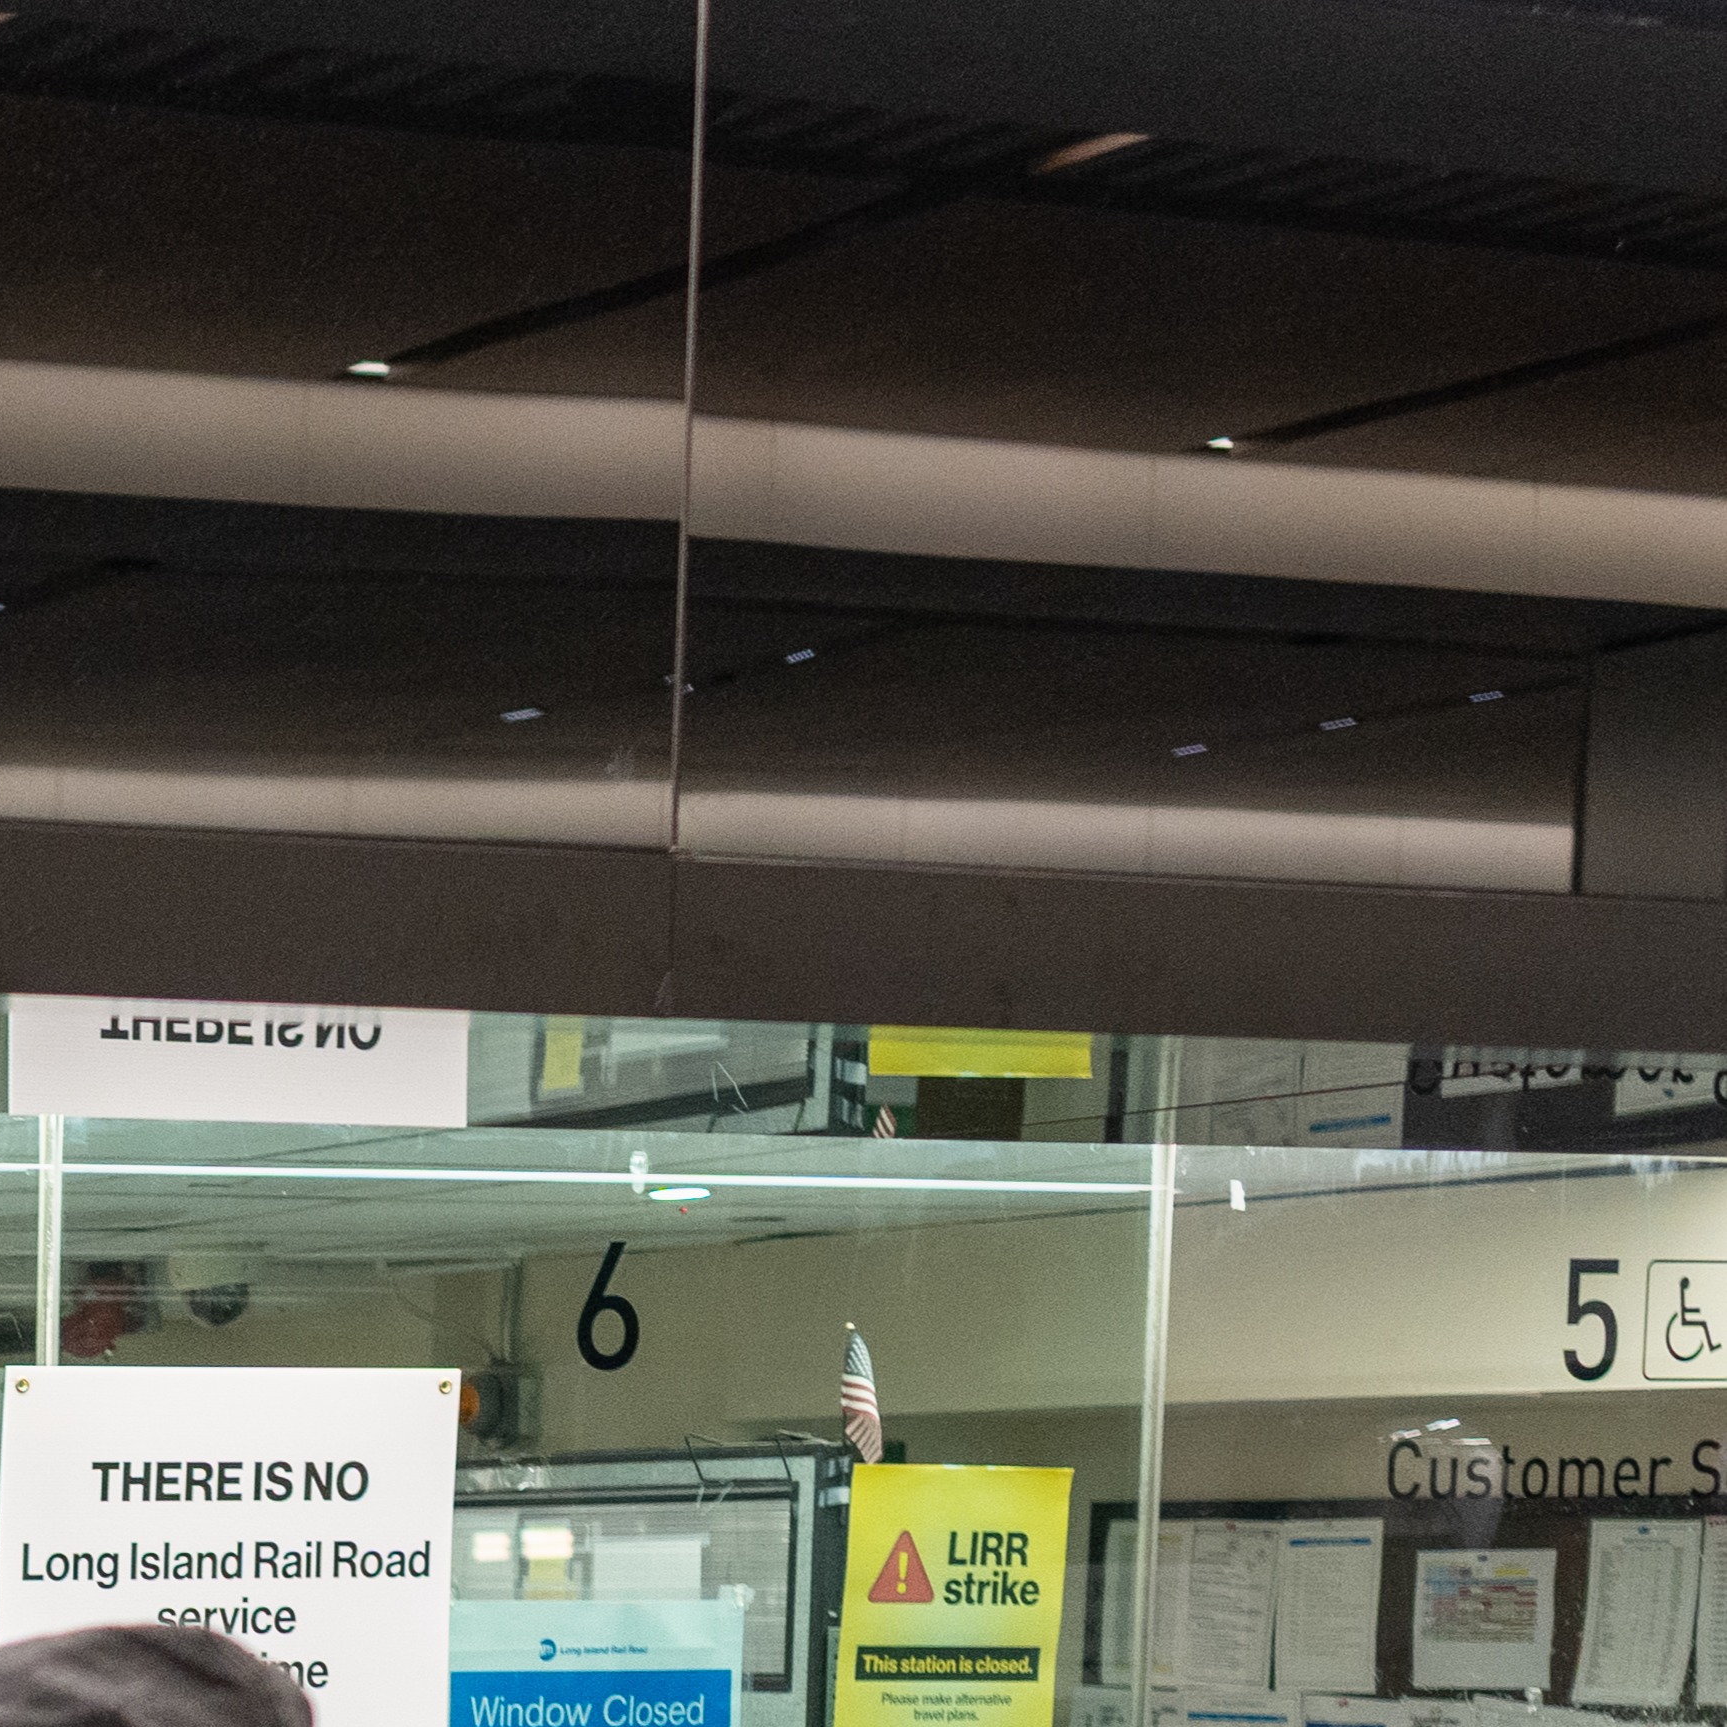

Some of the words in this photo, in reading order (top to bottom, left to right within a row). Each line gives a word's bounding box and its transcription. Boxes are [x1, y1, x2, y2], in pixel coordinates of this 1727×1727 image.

[577, 1241, 640, 1371] 6
[1562, 1258, 1620, 1382] 5
[91, 1461, 244, 1501] THERE
[253, 1461, 294, 1502] IS
[303, 1461, 370, 1502] NO
[1387, 1439, 1673, 1500] Customer
[1690, 1439, 1727, 1499] S
[22, 1543, 119, 1588] Long
[129, 1542, 244, 1580] Island
[253, 1541, 322, 1579] Rail
[333, 1541, 431, 1578] Road
[948, 1530, 1029, 1567] LIRR
[943, 1570, 1040, 1606] strike
[862, 1653, 898, 1674] This
[900, 1654, 957, 1674] station
[959, 1655, 973, 1674] is
[975, 1655, 1034, 1675] closed.
[470, 1696, 593, 1727] Window
[602, 1694, 705, 1727] Closed
[881, 1693, 920, 1706] Please
[922, 1693, 952, 1706] make
[955, 1693, 1012, 1706] alternative
[913, 1709, 945, 1722] travel
